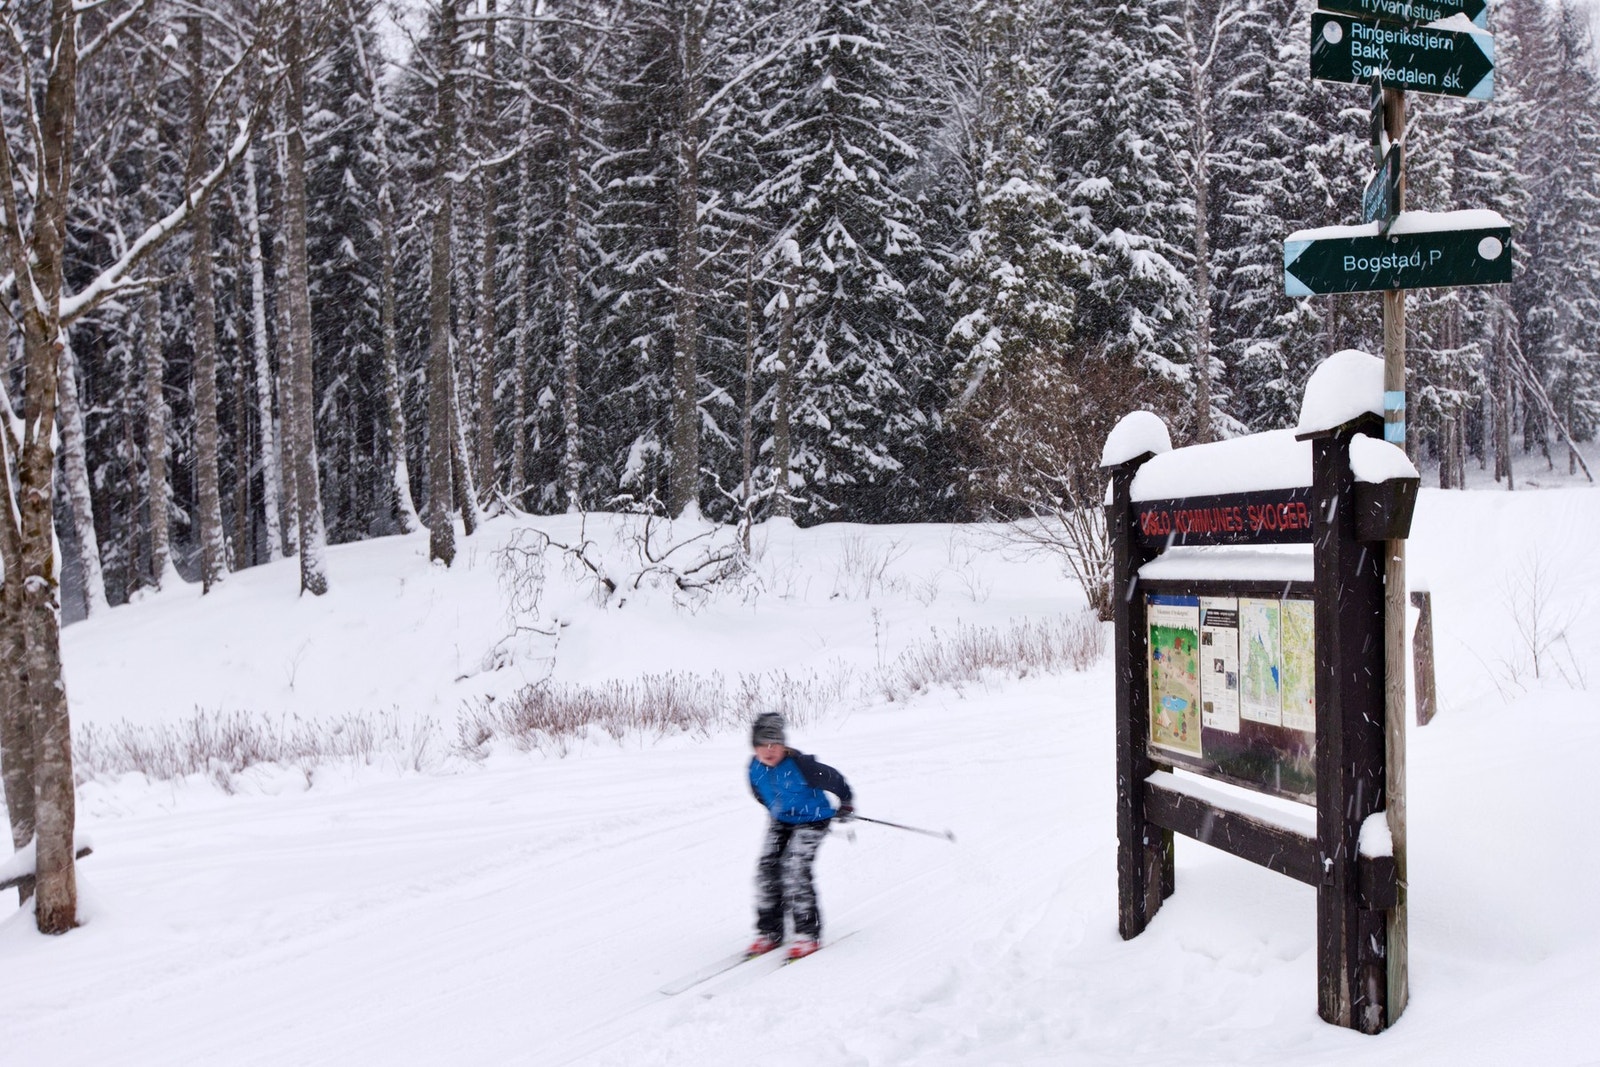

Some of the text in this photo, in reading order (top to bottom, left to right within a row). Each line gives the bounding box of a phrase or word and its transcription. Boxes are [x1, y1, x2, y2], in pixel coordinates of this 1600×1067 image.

[1351, 22, 1454, 51] Ringerikstjern
[1351, 41, 1389, 60] Bakk
[1351, 60, 1464, 89] Søkedalen sk.
[1343, 250, 1442, 273] Bogstad P
[1140, 502, 1310, 536] OSLO KOMMUNES SKOGER
